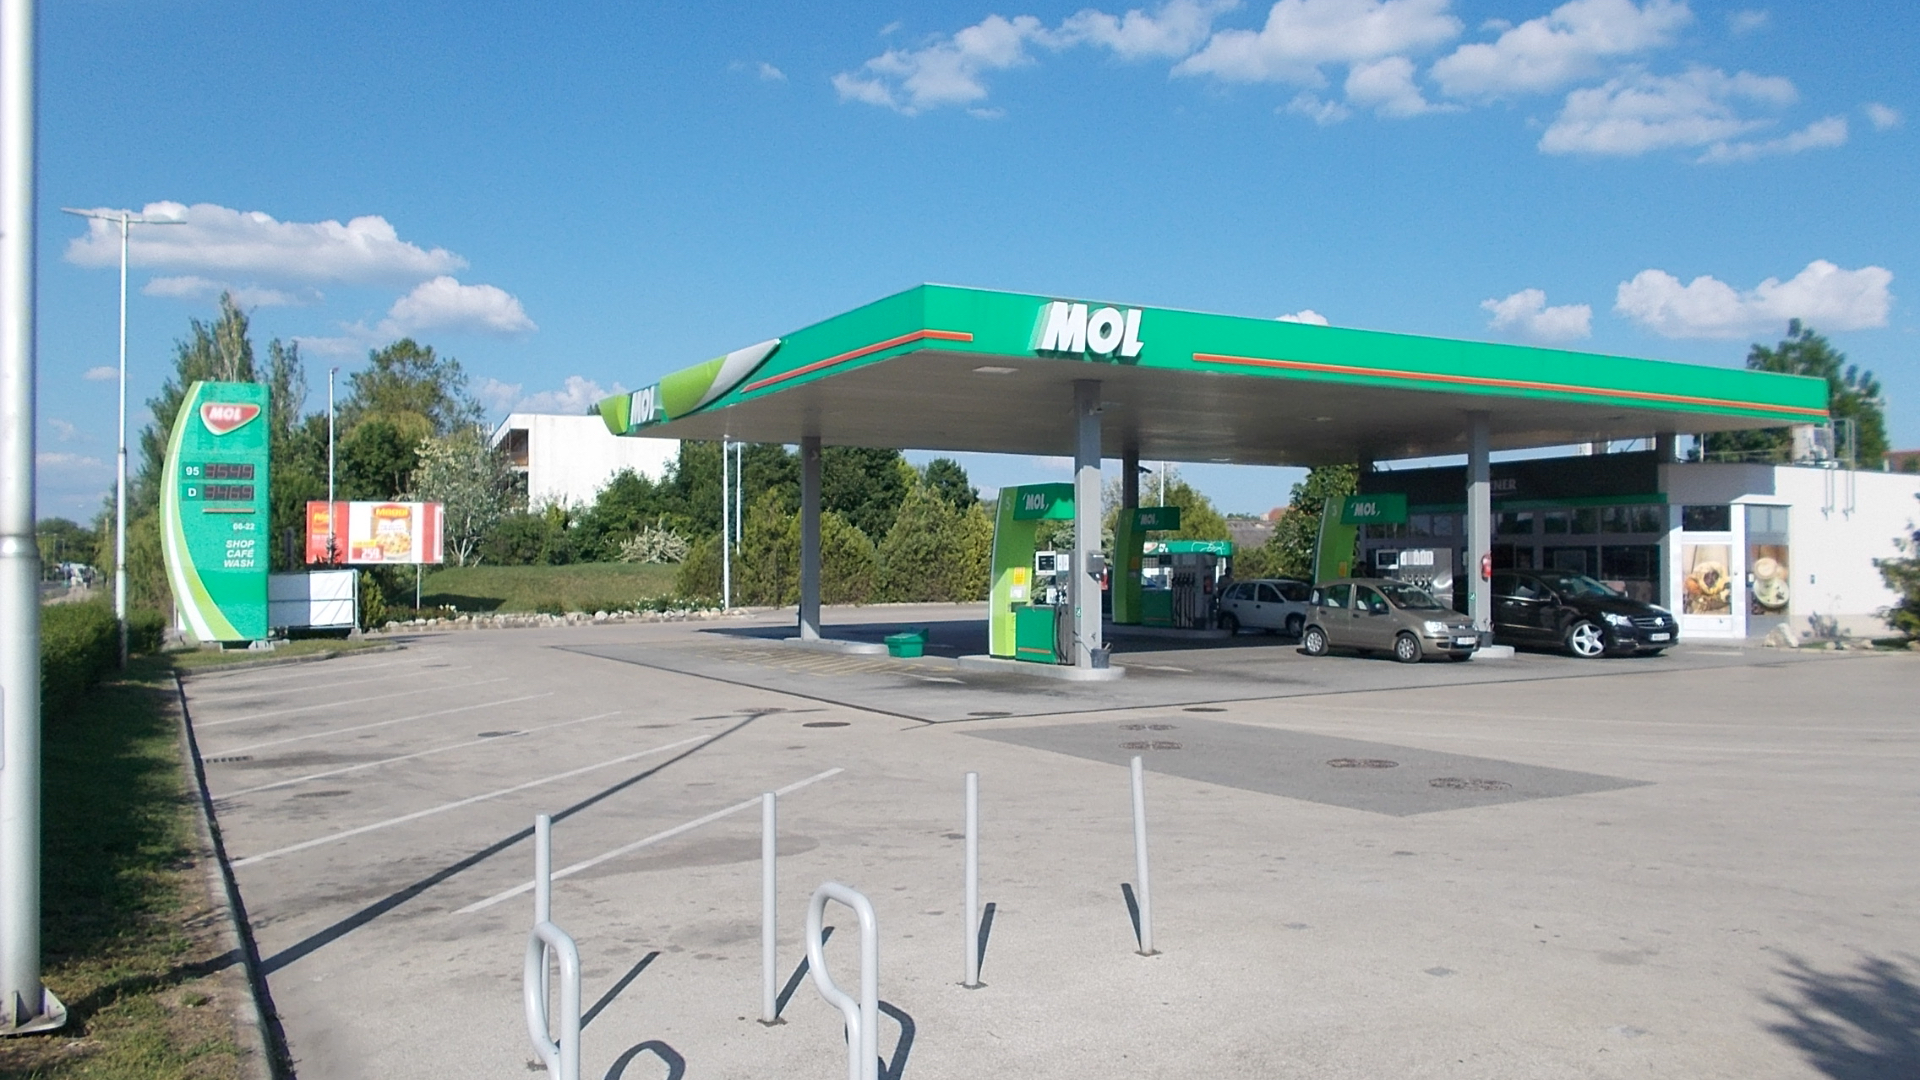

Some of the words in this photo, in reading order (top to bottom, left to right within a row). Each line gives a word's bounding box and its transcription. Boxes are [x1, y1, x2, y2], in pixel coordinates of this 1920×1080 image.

[1038, 301, 1144, 358] MOL
[630, 386, 655, 426] MOL
[209, 406, 242, 422] MOL
[185, 466, 200, 476] 95
[1490, 479, 1517, 491] NER
[187, 488, 197, 497] D
[1025, 493, 1046, 511] MOL
[1354, 502, 1376, 517] MOL
[225, 539, 255, 548] SHOP
[226, 548, 255, 558] CAFÉ
[223, 559, 255, 568] WASH
